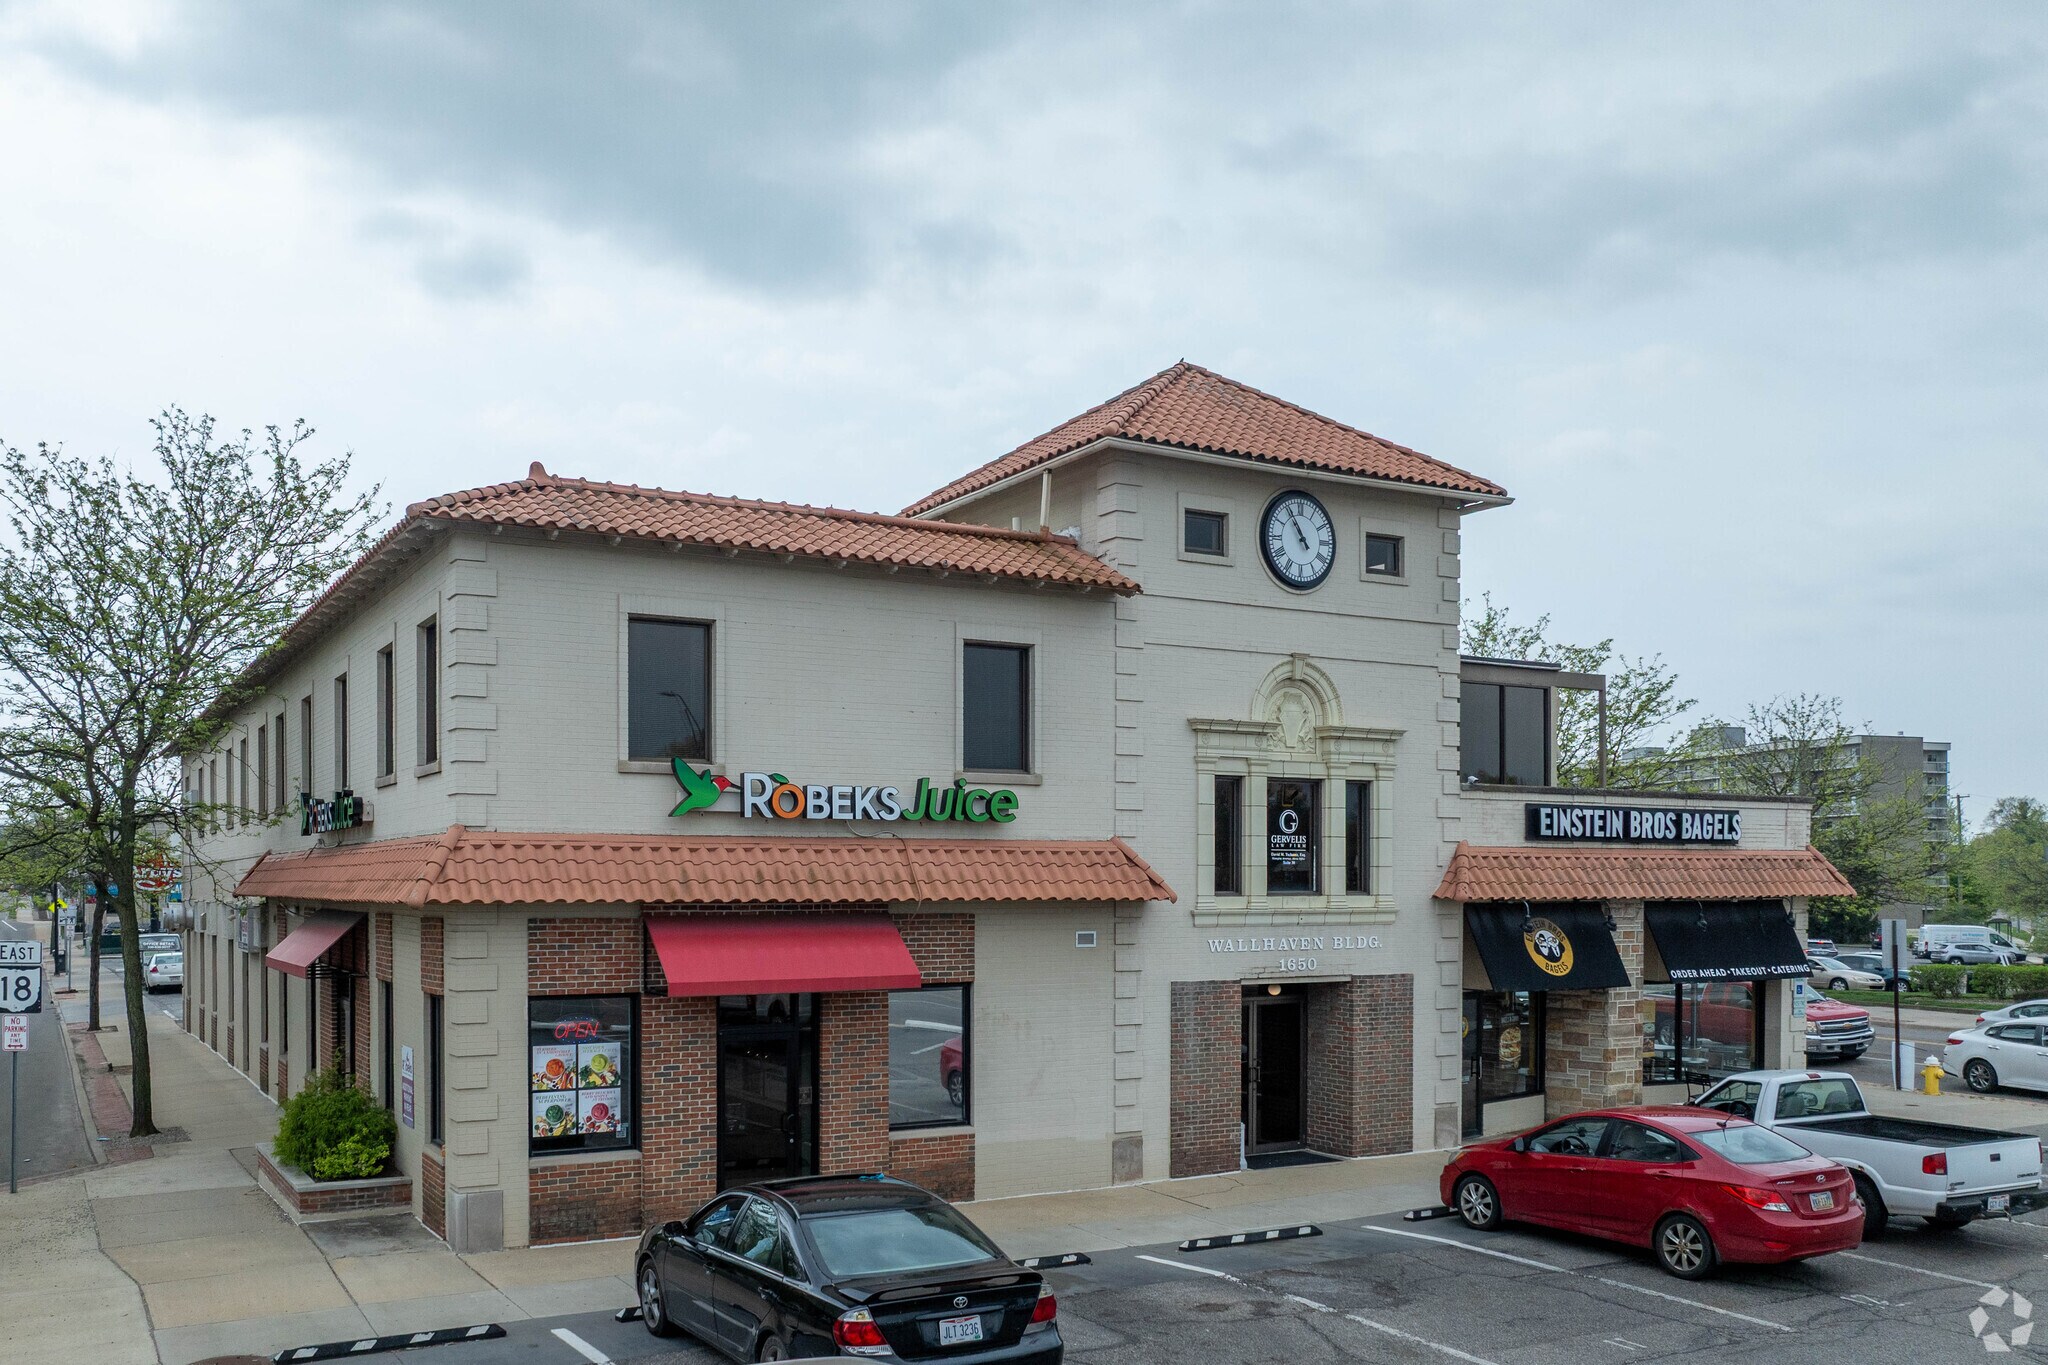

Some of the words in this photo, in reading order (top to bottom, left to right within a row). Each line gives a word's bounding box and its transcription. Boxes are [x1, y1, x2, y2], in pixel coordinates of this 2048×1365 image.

[902, 777, 1019, 823] Juice
[1540, 807, 1624, 839] EINSTEIN
[1630, 811, 1677, 840] BROS
[1681, 813, 1743, 841] BAGELS
[1271, 835, 1307, 844] GERVELIS
[1548, 921, 1566, 942] BROS
[0, 945, 34, 960] EAST
[1207, 937, 1325, 953] WALLHAVEN
[1332, 935, 1383, 949] BLDG.
[1279, 957, 1317, 971] 1650
[1545, 962, 1569, 974] BAGELS
[1670, 969, 1699, 979] ORDER
[1699, 968, 1727, 978] AHEAD
[1731, 966, 1767, 977] TAKEOUT
[1771, 964, 1810, 974] CATERING
[1, 976, 31, 1001] 18
[554, 1021, 599, 1039] OPEN
[943, 1325, 957, 1340] JLT
[959, 1322, 980, 1337] 3236
